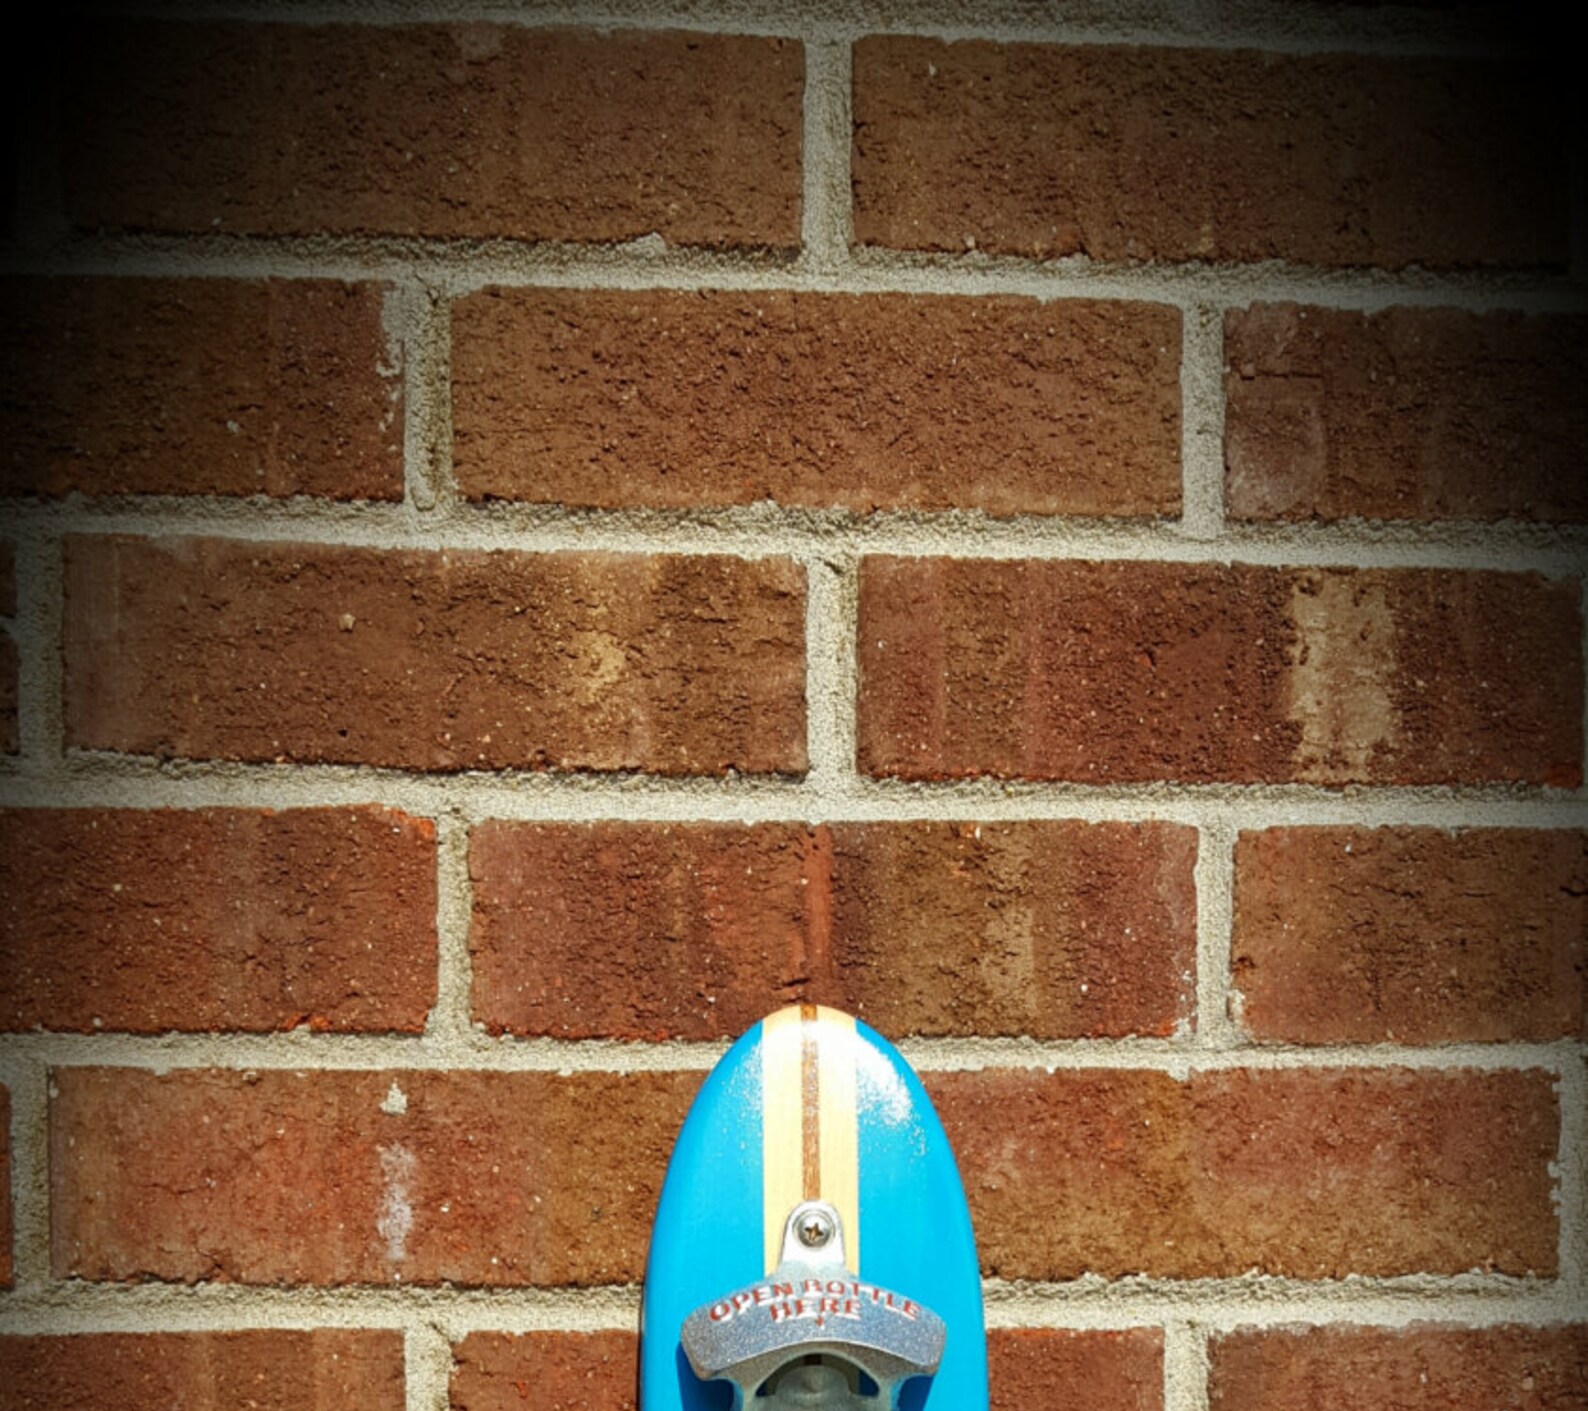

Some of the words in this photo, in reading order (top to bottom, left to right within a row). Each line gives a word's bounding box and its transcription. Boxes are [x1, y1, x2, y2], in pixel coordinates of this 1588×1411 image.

[709, 1282, 796, 1322] OPEN
[803, 1279, 921, 1321] BOTTLE
[769, 1298, 861, 1323] HERE
